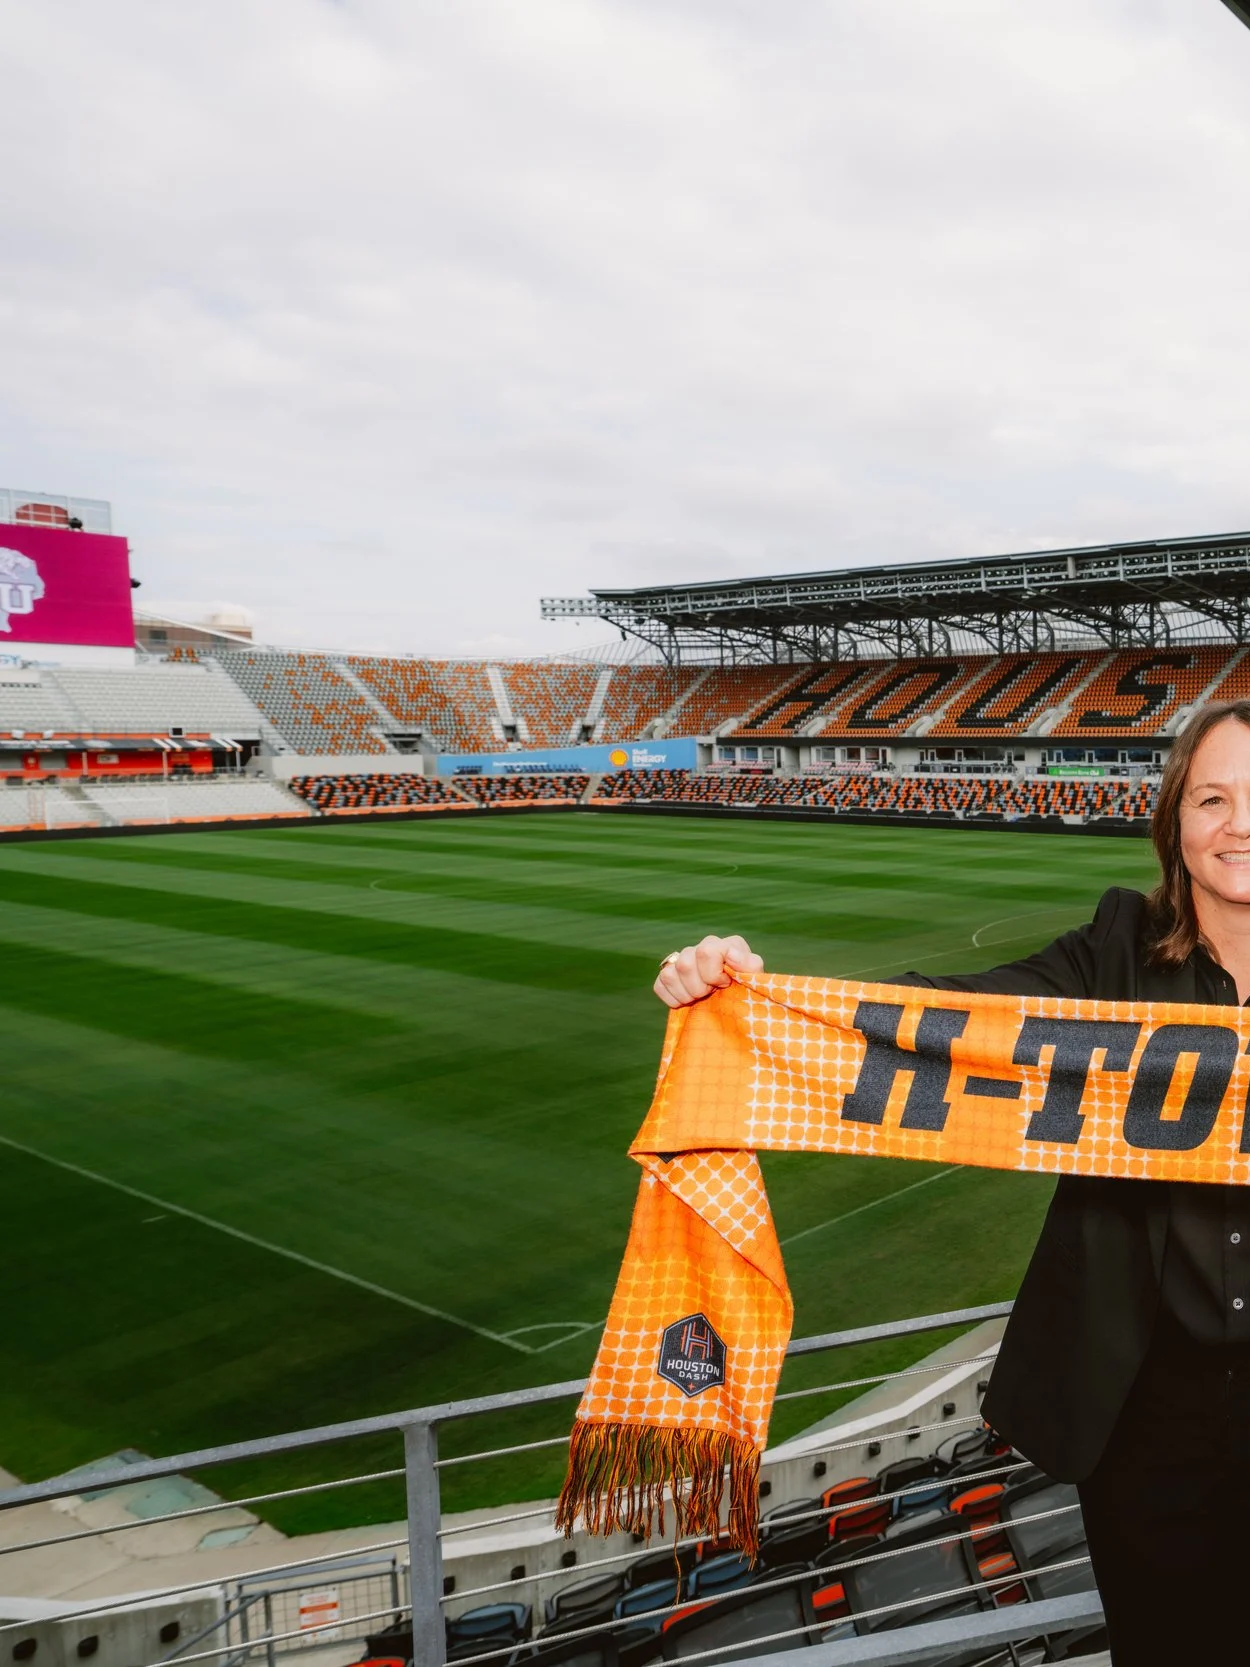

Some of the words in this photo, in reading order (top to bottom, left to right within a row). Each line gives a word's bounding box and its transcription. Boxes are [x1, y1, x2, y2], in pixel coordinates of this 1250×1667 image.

[632, 754, 667, 763] ENERGY
[666, 1359, 720, 1377] HOUSTON
[678, 1370, 708, 1380] DASH
